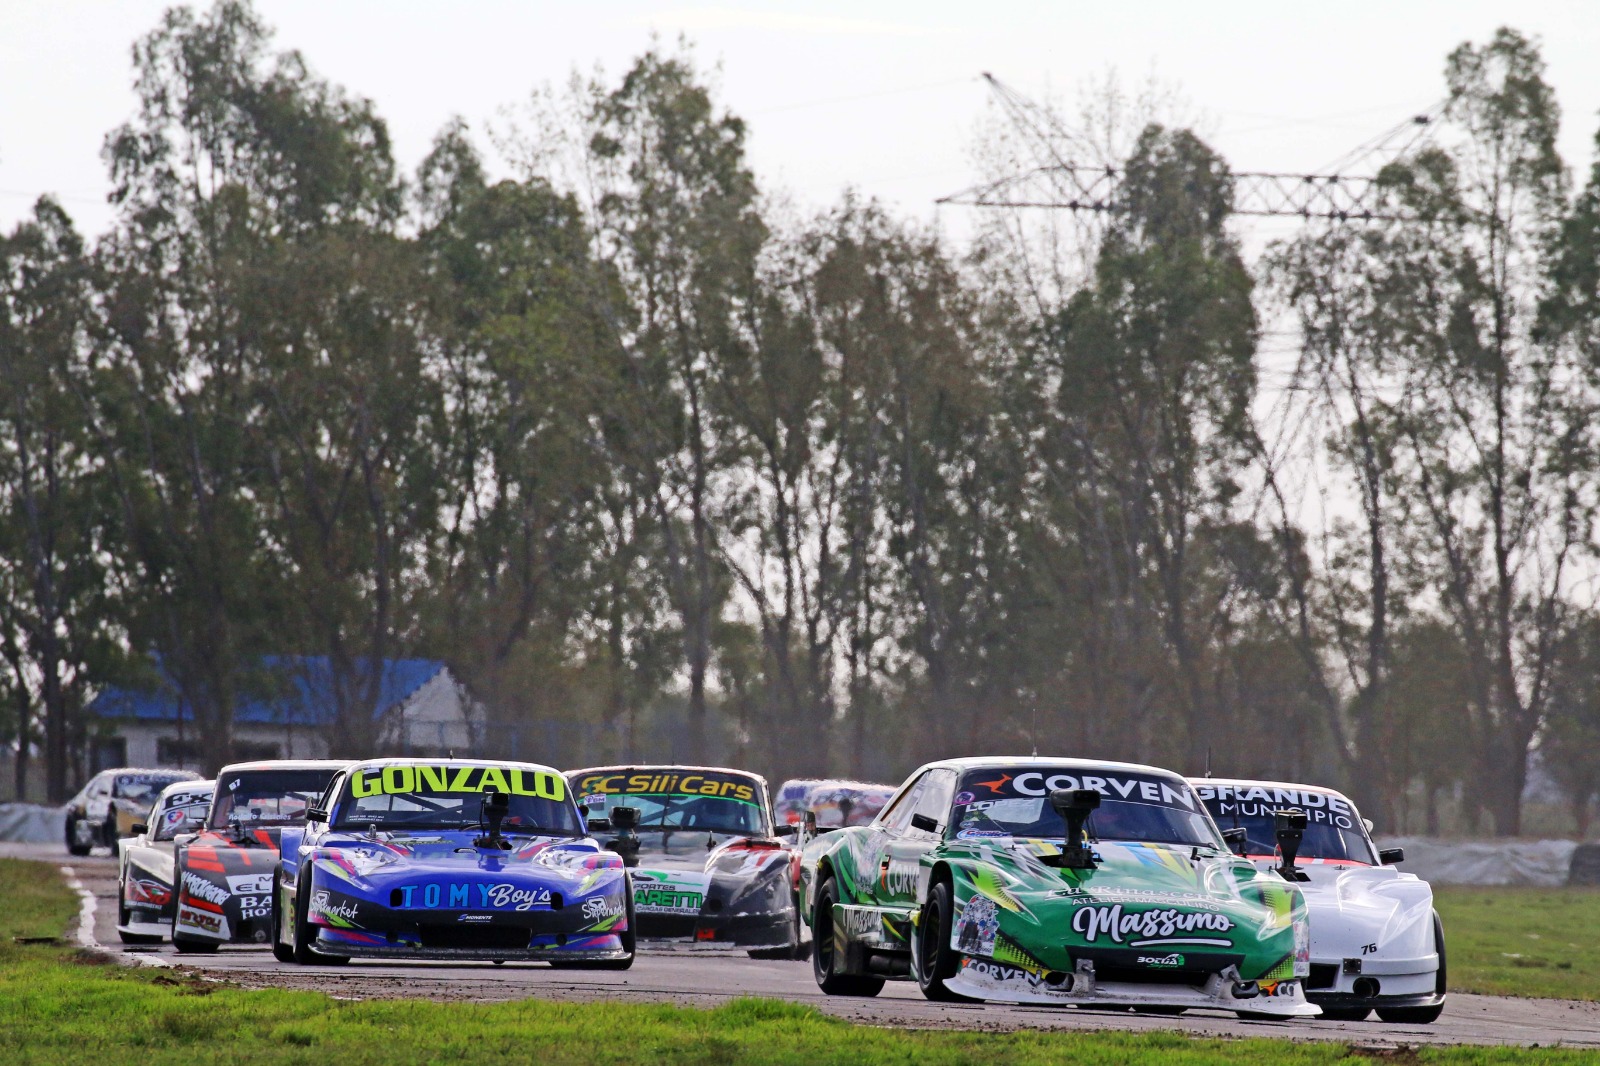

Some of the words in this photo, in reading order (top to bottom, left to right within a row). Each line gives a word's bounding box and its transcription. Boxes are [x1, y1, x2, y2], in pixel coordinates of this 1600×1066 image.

[352, 766, 564, 801] GONZALO
[1013, 772, 1195, 811] CORVEN
[1196, 785, 1351, 816] GRANDE
[401, 883, 494, 908] TOMY
[488, 883, 552, 911] Boy's
[634, 889, 703, 909] ARETTI
[1072, 904, 1235, 942] Massimo
[1361, 943, 1377, 955] 76
